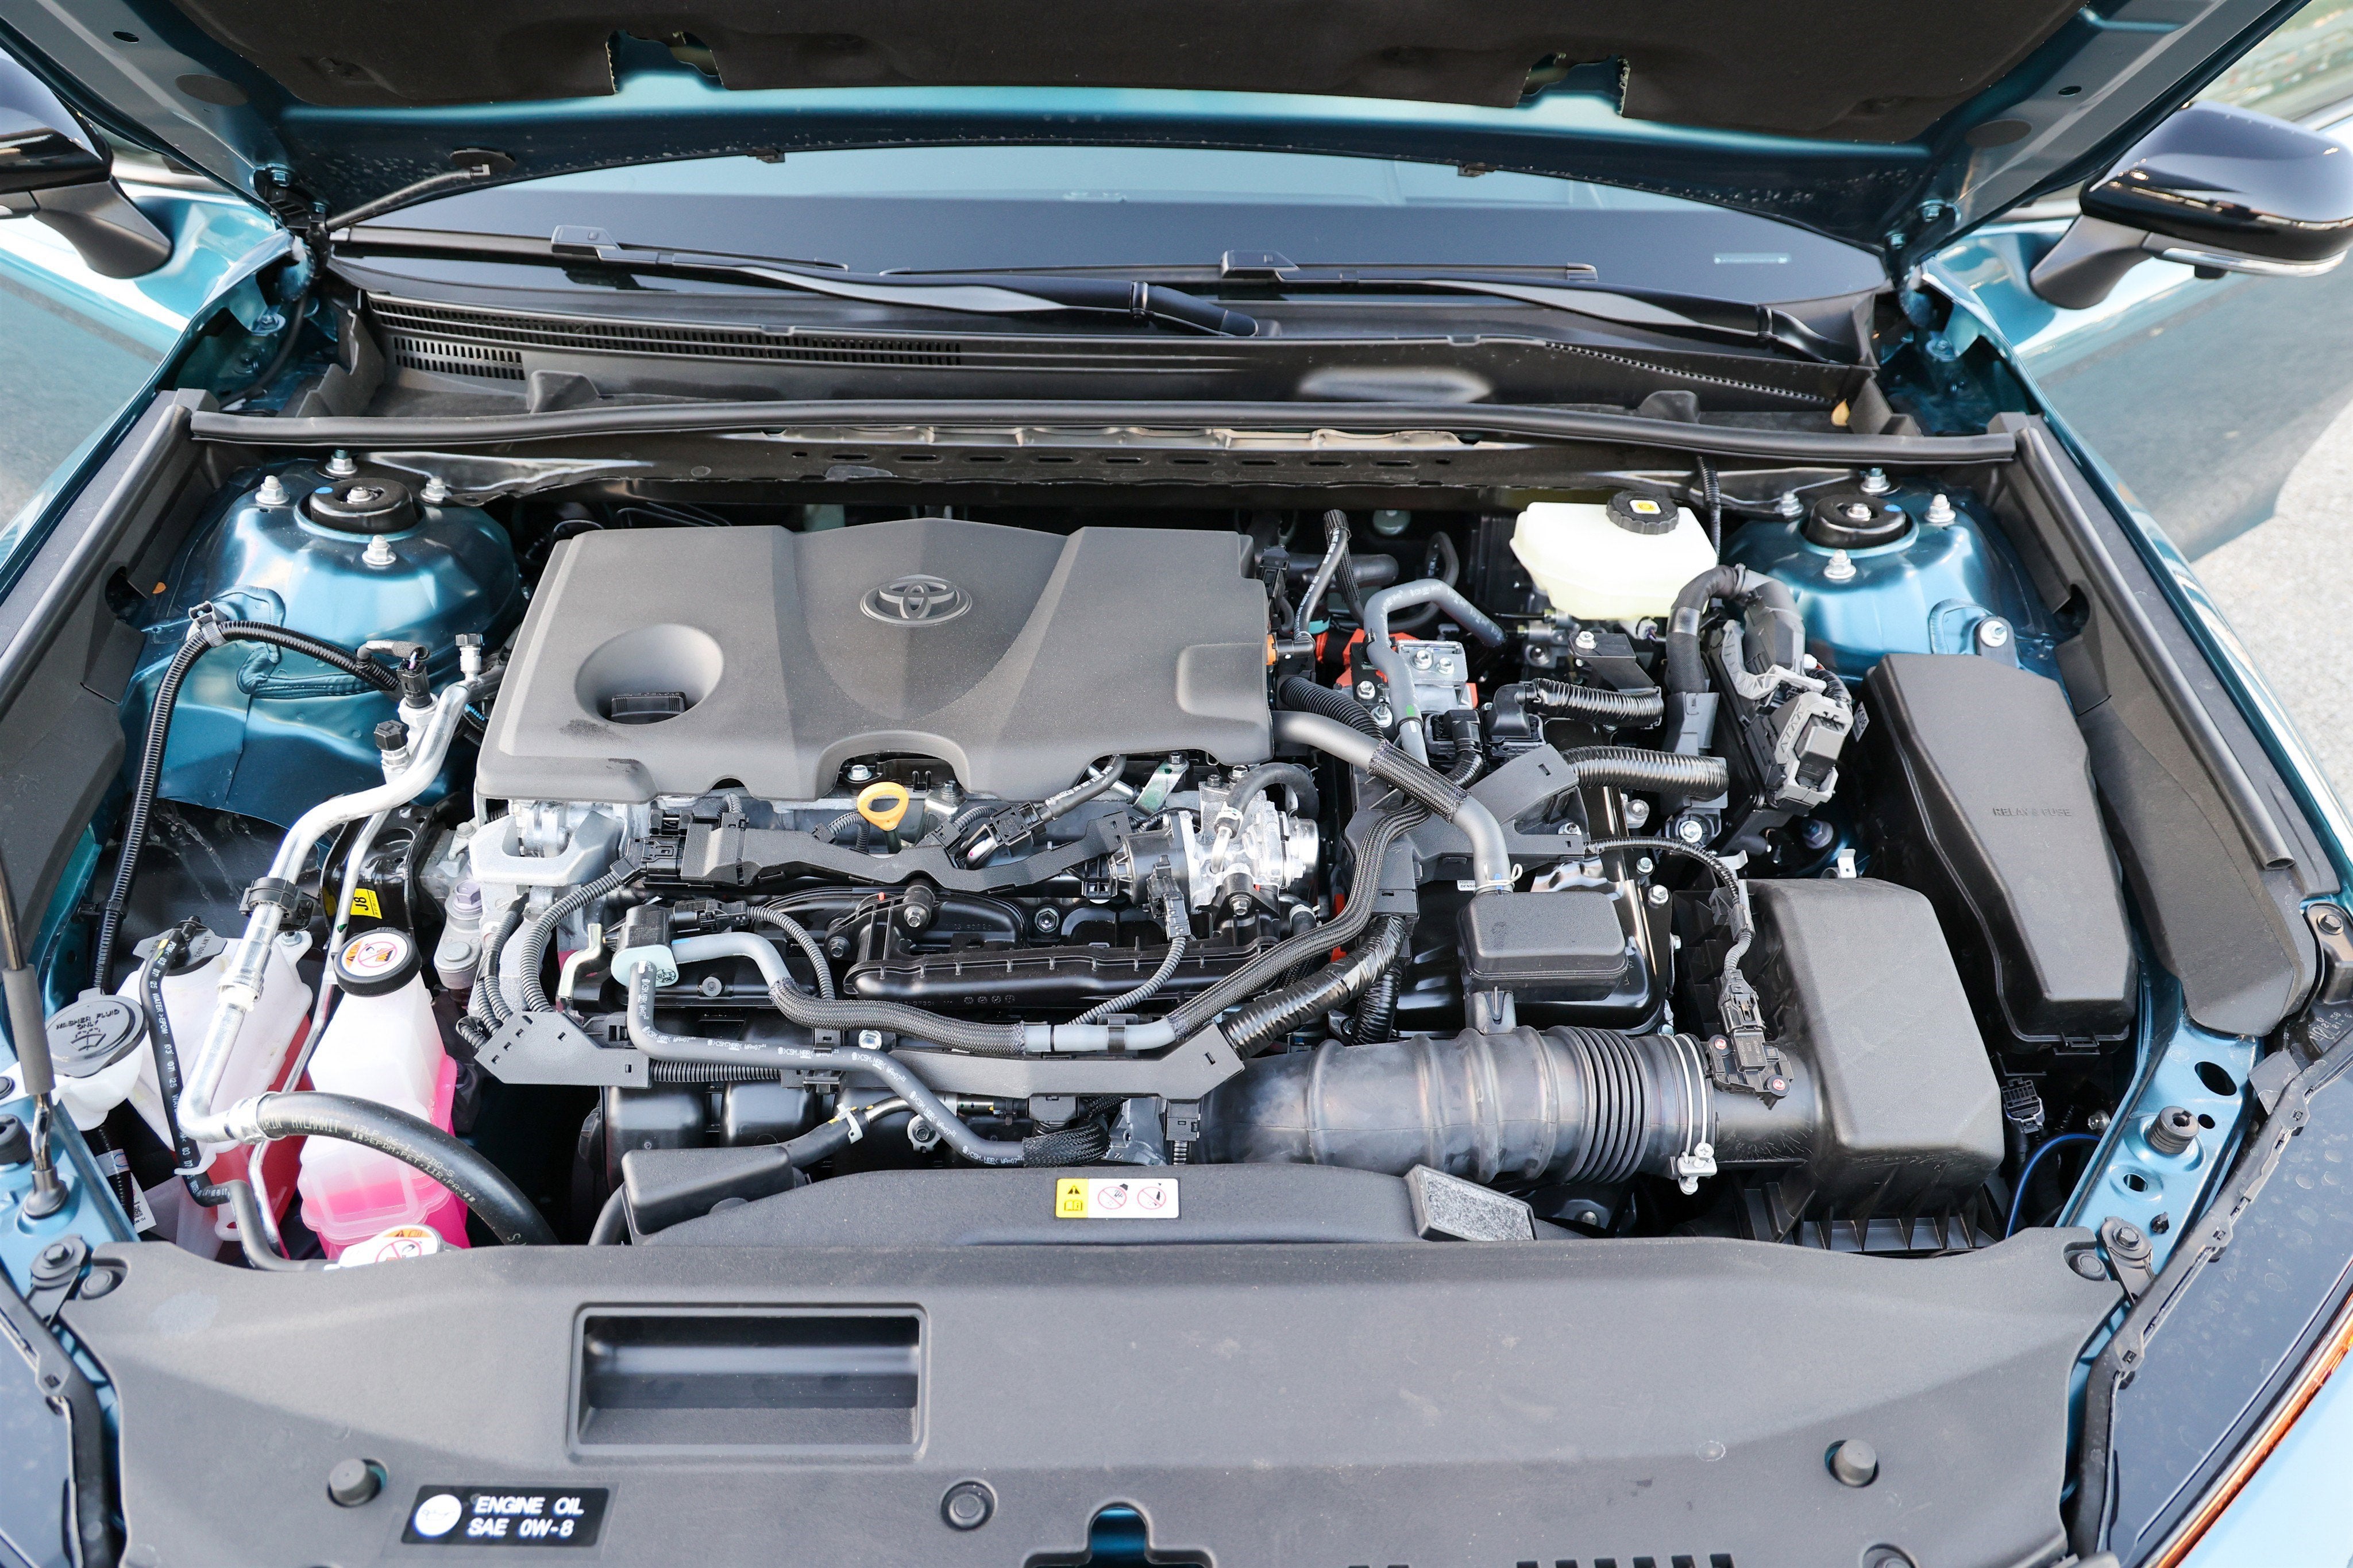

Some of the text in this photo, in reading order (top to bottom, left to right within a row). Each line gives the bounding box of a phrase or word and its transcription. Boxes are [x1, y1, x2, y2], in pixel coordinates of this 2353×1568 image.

[1992, 808, 2028, 816] RELAY
[2042, 808, 2072, 816] FUSE
[353, 897, 369, 911] J8
[194, 936, 211, 958] COOLANT
[152, 992, 164, 1013] WATER
[55, 1009, 120, 1031] WASHER FLUID
[76, 1019, 99, 1030] ONLY
[473, 1496, 585, 1516] ENGINE OIL
[466, 1517, 575, 1538] SAE 0W-8
